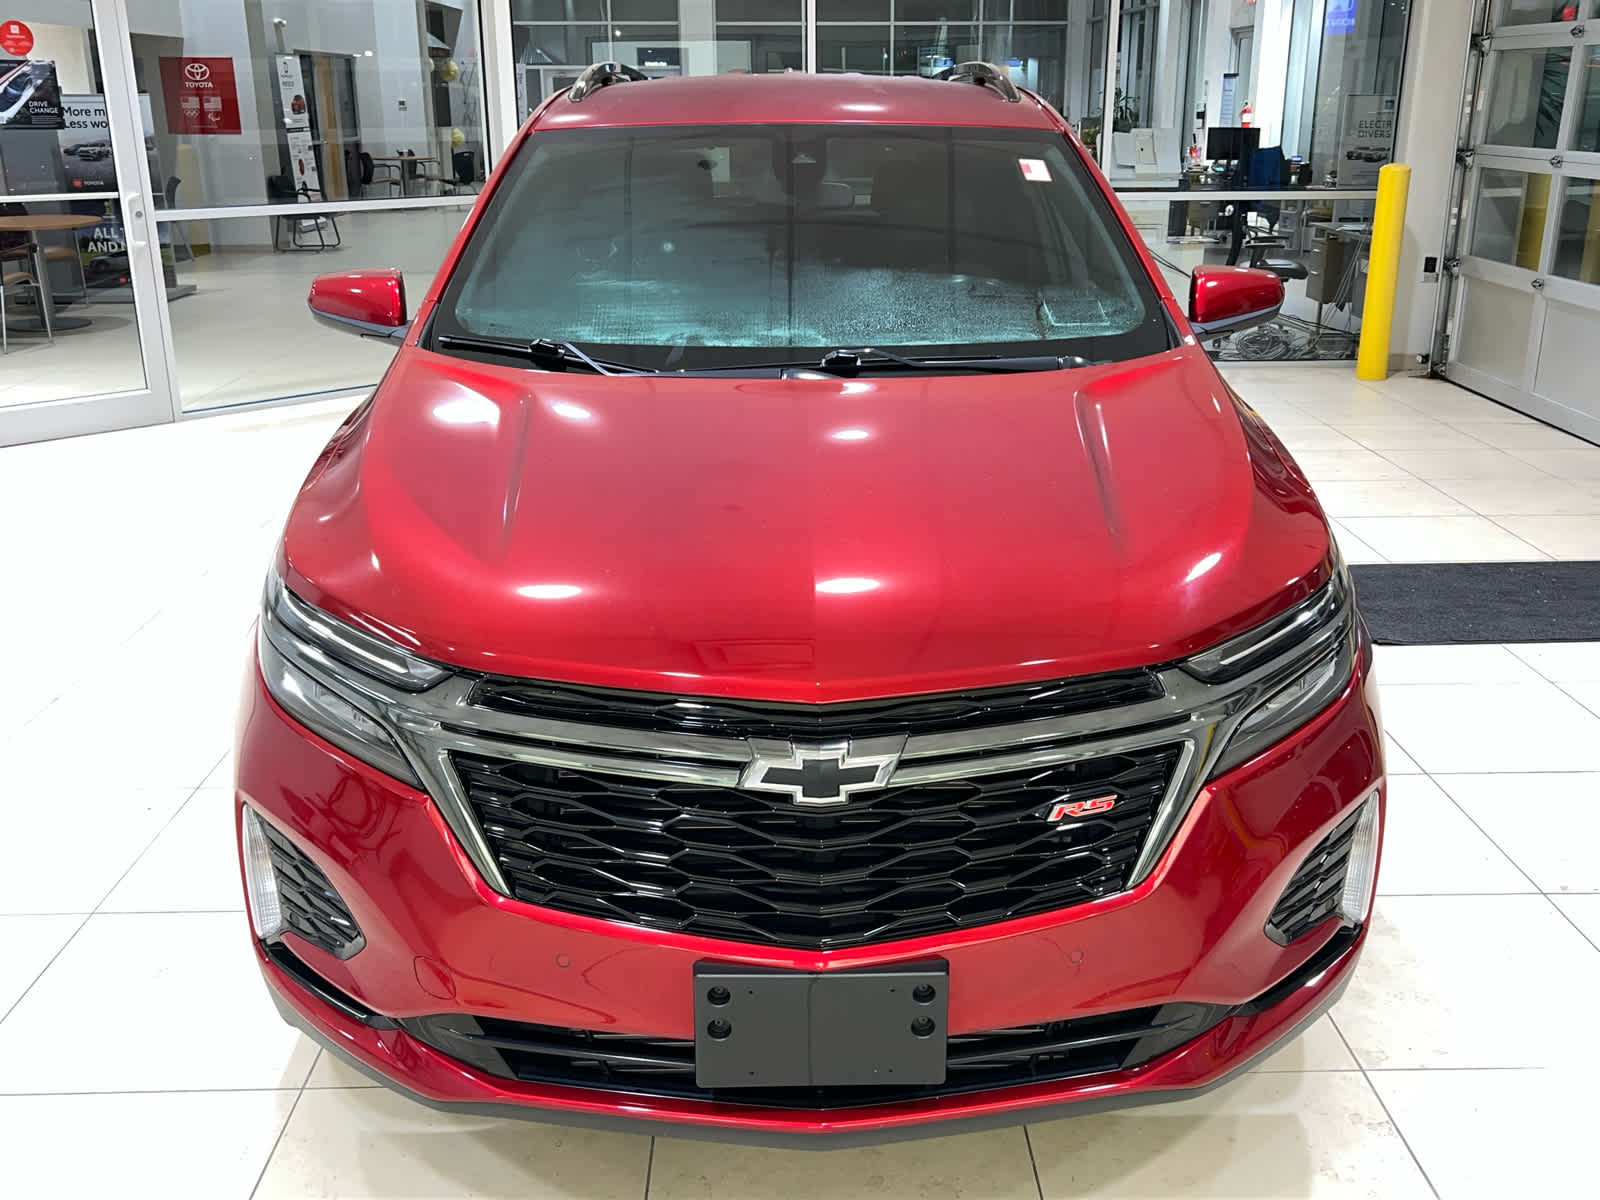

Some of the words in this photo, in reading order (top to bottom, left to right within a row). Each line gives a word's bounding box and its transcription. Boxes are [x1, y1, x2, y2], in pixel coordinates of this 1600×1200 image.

[63, 107, 92, 117] More
[64, 120, 89, 129] Less
[94, 227, 119, 239] ALL
[87, 241, 118, 253] AND
[1046, 794, 1118, 822] RS
